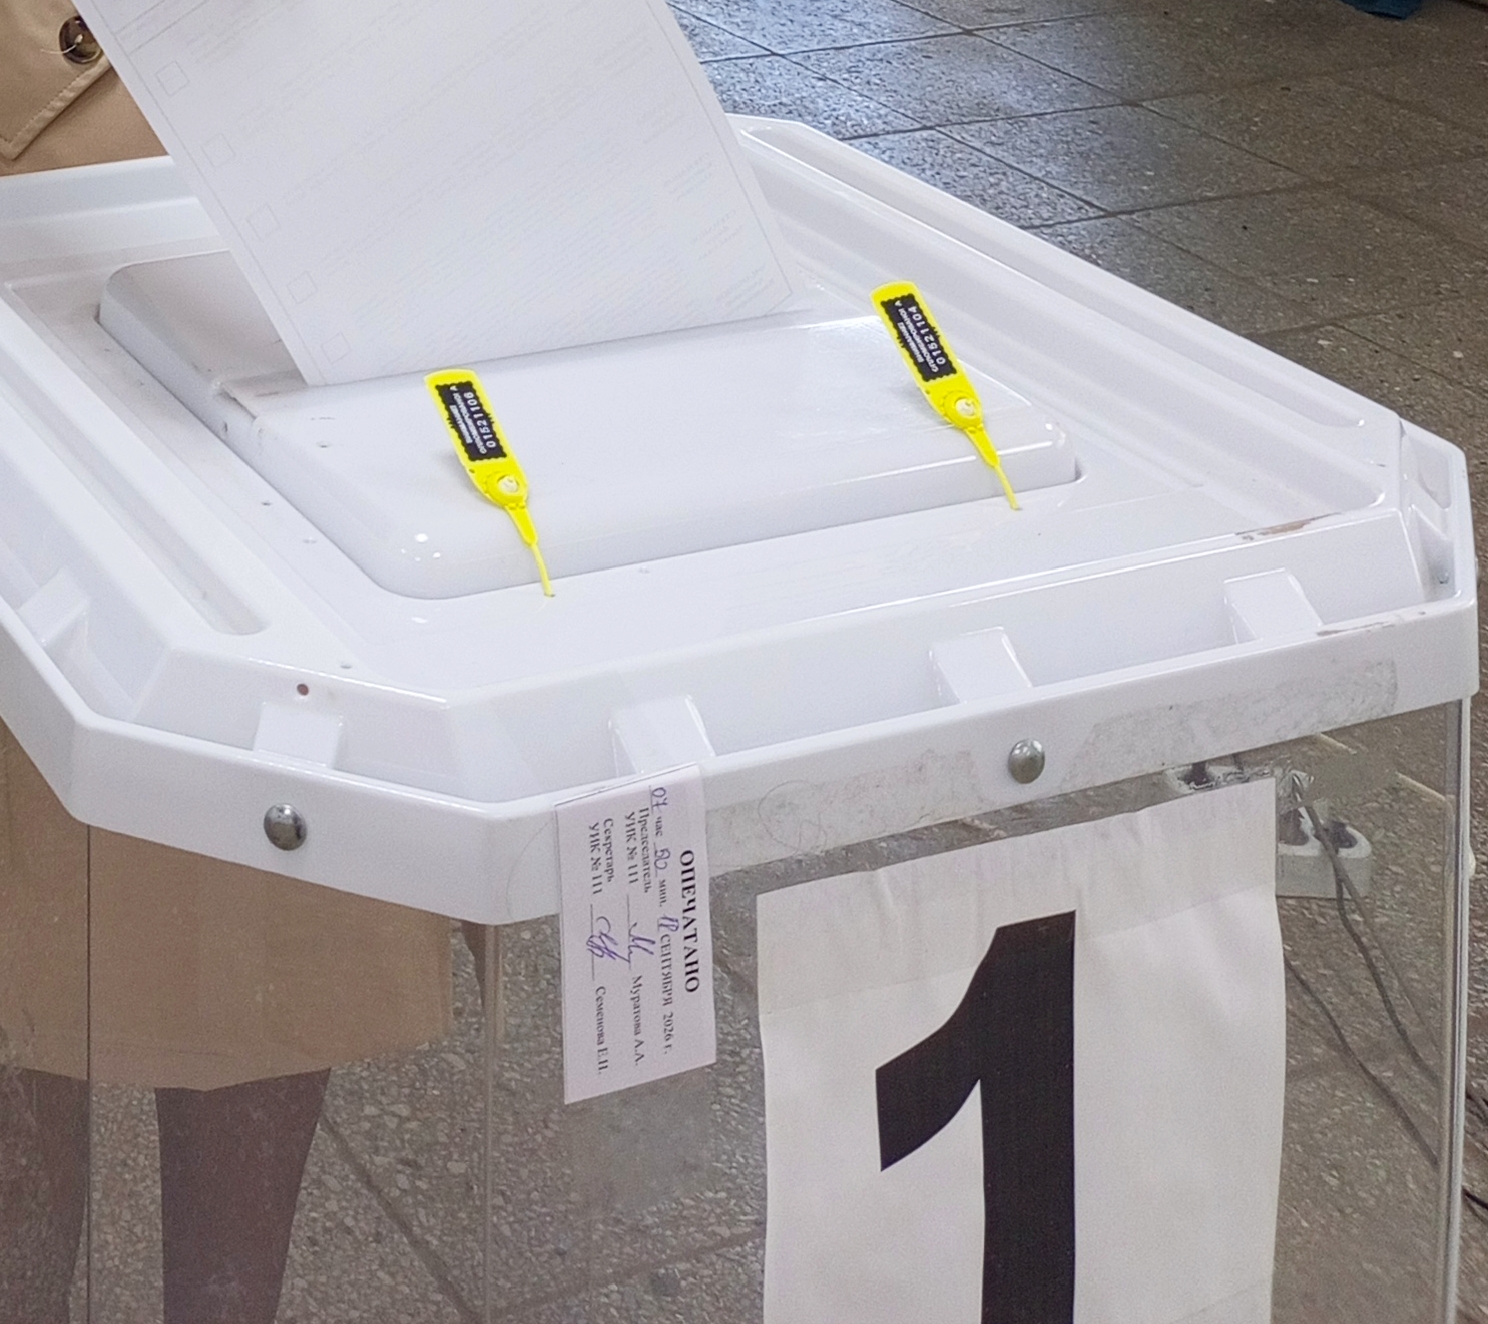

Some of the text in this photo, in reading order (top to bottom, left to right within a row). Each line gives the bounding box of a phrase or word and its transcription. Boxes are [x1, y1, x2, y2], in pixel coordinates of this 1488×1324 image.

[908, 306, 946, 365] 01521104
[463, 392, 496, 448] 01521106
[589, 822, 601, 853] УИК
[625, 812, 637, 843] УИК
[655, 816, 663, 837] час
[591, 857, 601, 871] №
[603, 818, 614, 882] Секретарь
[627, 846, 637, 861] №
[638, 807, 652, 893] Председатель
[592, 875, 602, 894] 111
[628, 864, 638, 884] 111
[679, 850, 700, 993] ОПЕЧАТАНО
[660, 934, 673, 1006] СЕНТЯБРЯ
[595, 986, 607, 1046] Семенова
[630, 975, 642, 1036] Муратова
[663, 1012, 674, 1042] 2026
[664, 1043, 673, 1055] г.
[875, 909, 1076, 1324] 1
